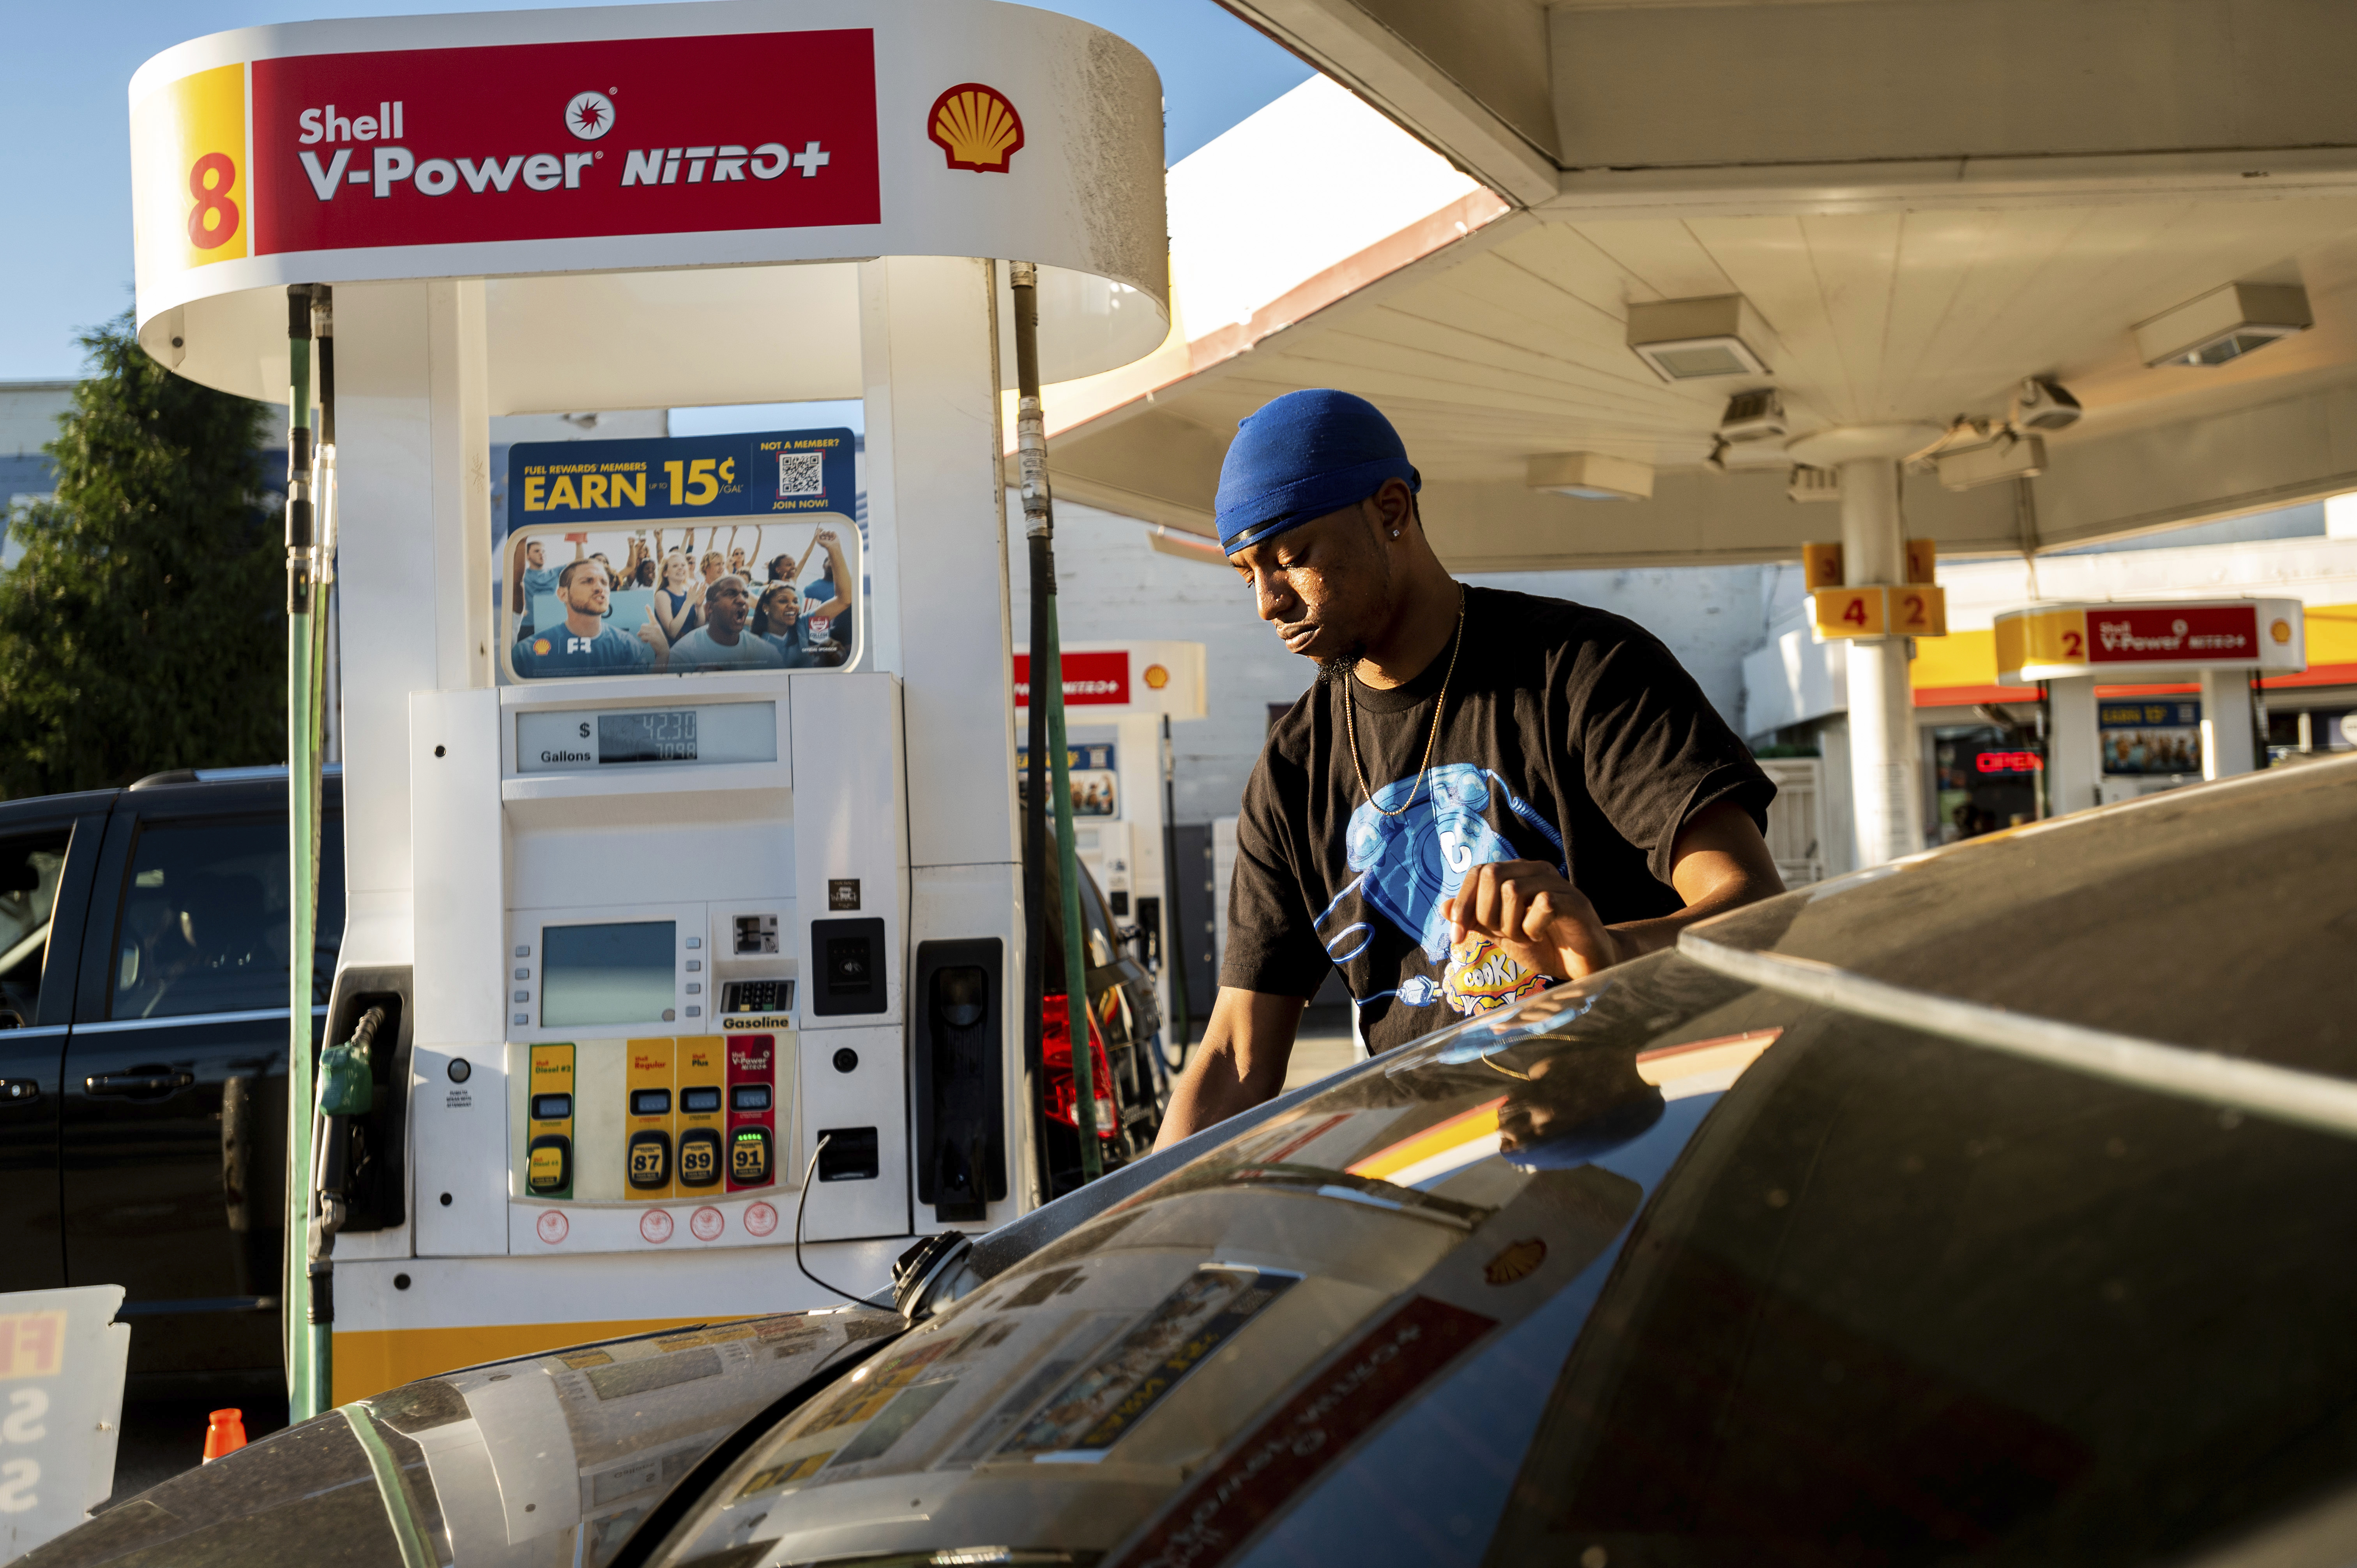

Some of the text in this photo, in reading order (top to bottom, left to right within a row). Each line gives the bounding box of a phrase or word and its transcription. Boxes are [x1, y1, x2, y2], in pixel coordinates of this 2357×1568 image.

[299, 101, 403, 144] Shell
[188, 152, 240, 250] 8
[761, 438, 839, 450] NOT A MEMBER?
[525, 466, 547, 475] FUEL
[600, 462, 647, 473] MEMBERS
[525, 472, 646, 512] EARN
[772, 499, 829, 510] JOIN NOW!
[1843, 597, 1867, 627] 4
[1904, 595, 1925, 626] 2
[2062, 631, 2081, 657] 2
[579, 722, 590, 739] $
[541, 750, 590, 763] Gallons
[1977, 752, 2044, 773] OPEN
[723, 1016, 788, 1029] Gasoline
[635, 1060, 666, 1070] Regular
[634, 1155, 660, 1171] 87
[685, 1153, 711, 1169] 89
[735, 1150, 761, 1167] 91
